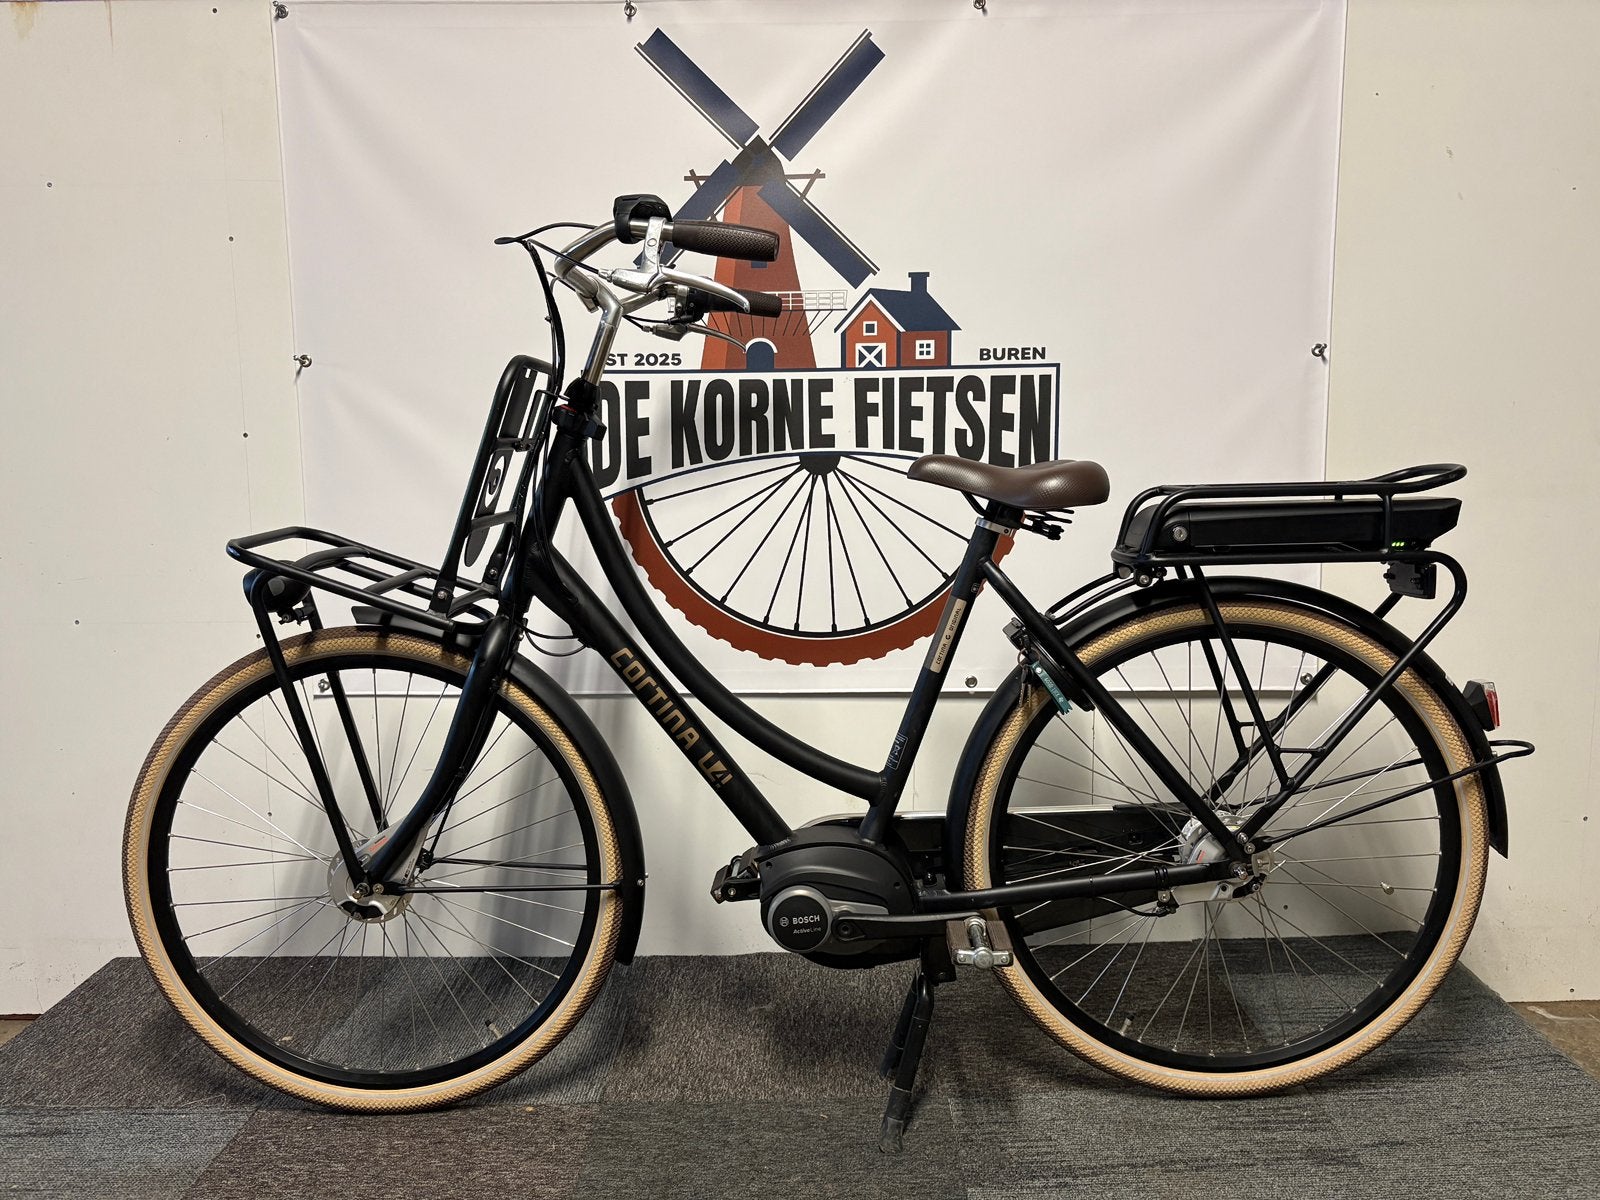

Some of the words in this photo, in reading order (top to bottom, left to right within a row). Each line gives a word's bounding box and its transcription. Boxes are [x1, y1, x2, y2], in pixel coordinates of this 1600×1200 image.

[605, 353, 628, 366] ST
[634, 353, 682, 366] 2025
[979, 347, 1047, 361] BUREN
[592, 380, 652, 488] DE
[670, 378, 835, 469] KORNE
[854, 374, 1052, 468] FIETSEN
[611, 647, 700, 750] CORTINA
[792, 914, 820, 925] BOSCH
